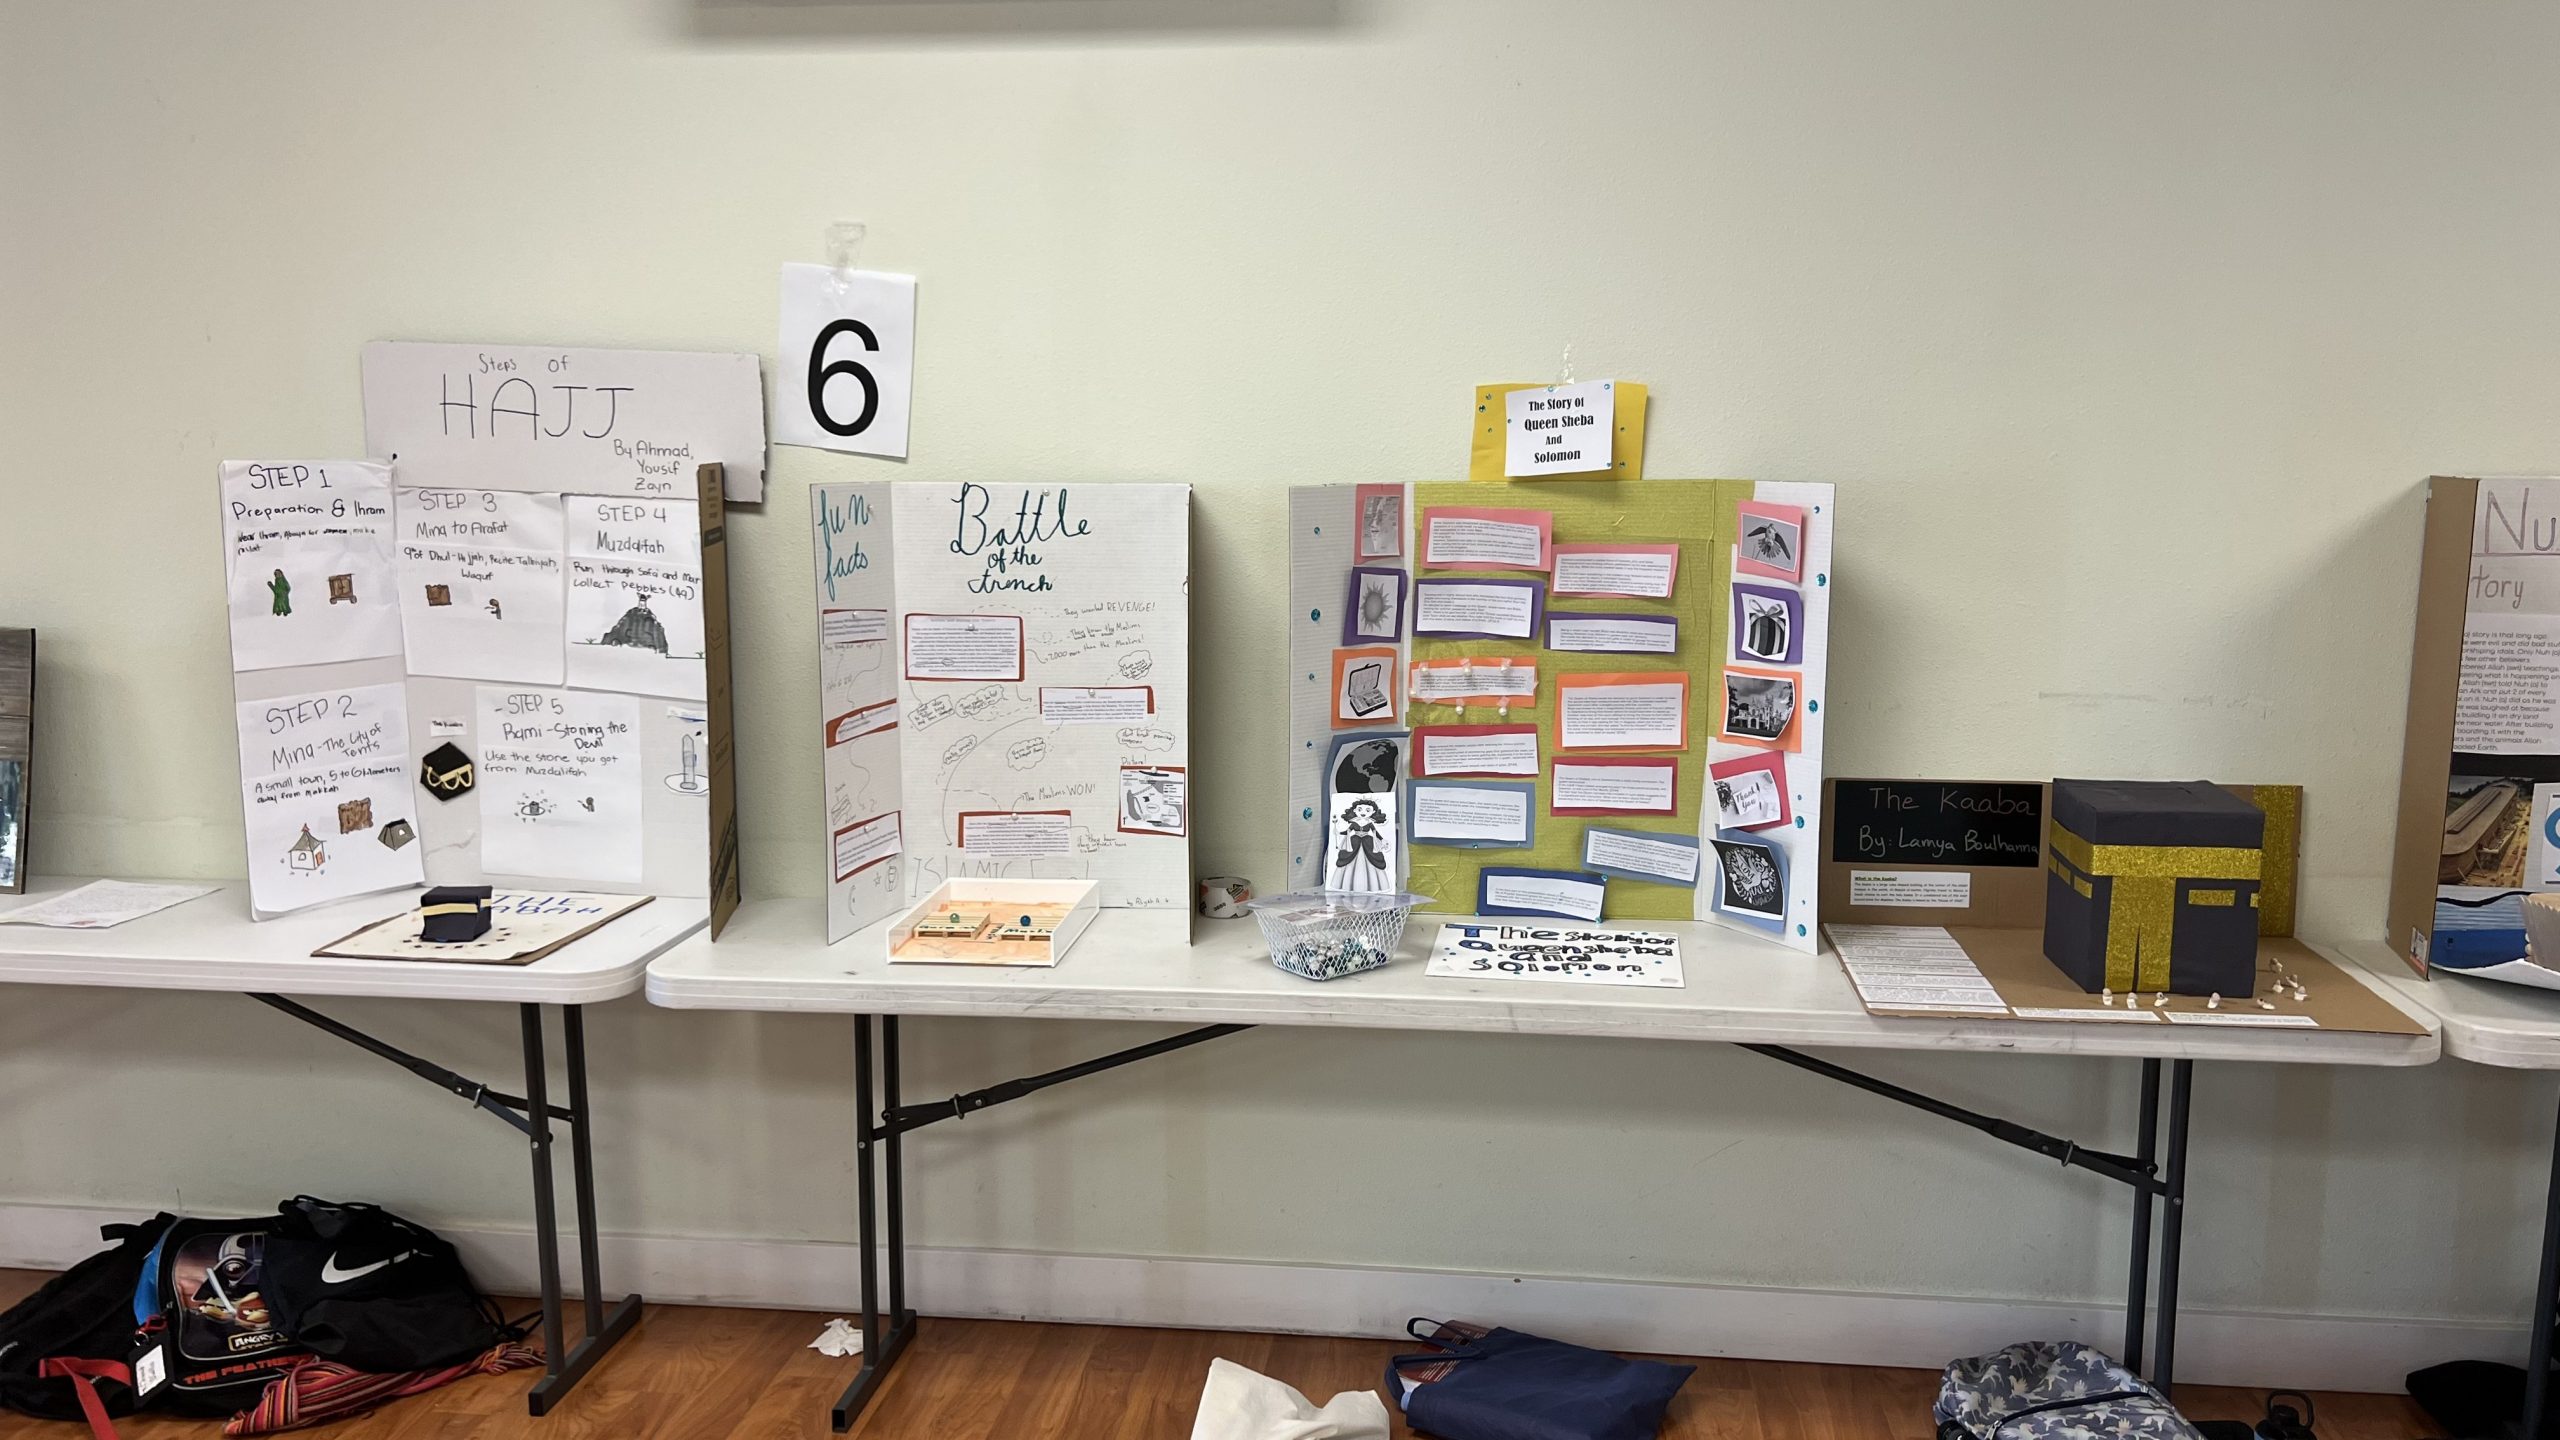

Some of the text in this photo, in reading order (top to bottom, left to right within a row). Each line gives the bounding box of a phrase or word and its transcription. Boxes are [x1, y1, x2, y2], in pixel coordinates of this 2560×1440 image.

[479, 353, 517, 374] Steps
[807, 318, 880, 437] 6
[439, 373, 635, 441] HAJJ
[1528, 397, 1585, 411] The Story Of
[1524, 414, 1594, 432] Queen Sheba
[613, 438, 695, 460] By Ahmad,
[1545, 435, 1562, 445] And
[1534, 450, 1581, 464] Solomon
[249, 464, 332, 489] STEP 1
[636, 460, 681, 476] Yousif
[634, 477, 672, 494] Zayn
[232, 498, 385, 520] Preparation & Ihram
[419, 490, 497, 512] STEP 3
[598, 504, 667, 523] STEP 4
[950, 482, 1092, 556] Battle
[416, 521, 509, 538] Mina to Arafat
[987, 545, 1043, 573] of the
[573, 561, 594, 573] Run
[663, 571, 678, 580] and
[967, 568, 1054, 594] trench
[1064, 608, 1078, 618] They
[1107, 602, 1156, 612] REVENGE!
[2515, 632, 2532, 640] long
[266, 695, 358, 735] STEP 2
[550, 697, 564, 715] 5
[502, 721, 628, 742] Rami the
[272, 744, 315, 771] Mina
[370, 722, 382, 737] of
[342, 741, 380, 757] Tents
[485, 751, 619, 766] Use the stone you got
[484, 765, 518, 773] from
[255, 782, 263, 794] A
[265, 777, 293, 791] small
[299, 775, 326, 786] town,
[329, 769, 338, 782] 5
[339, 770, 350, 778] to
[351, 767, 362, 778] 6
[1067, 783, 1096, 796] WON!
[280, 790, 301, 800] from
[1735, 786, 1755, 803] Thank
[1869, 787, 2037, 816] The Kaaba
[1858, 824, 1893, 858] By:
[1898, 827, 1957, 858] Lamya
[1445, 923, 1560, 941] The
[235, 1333, 274, 1347] ANGRY
[183, 1370, 218, 1385] THE
